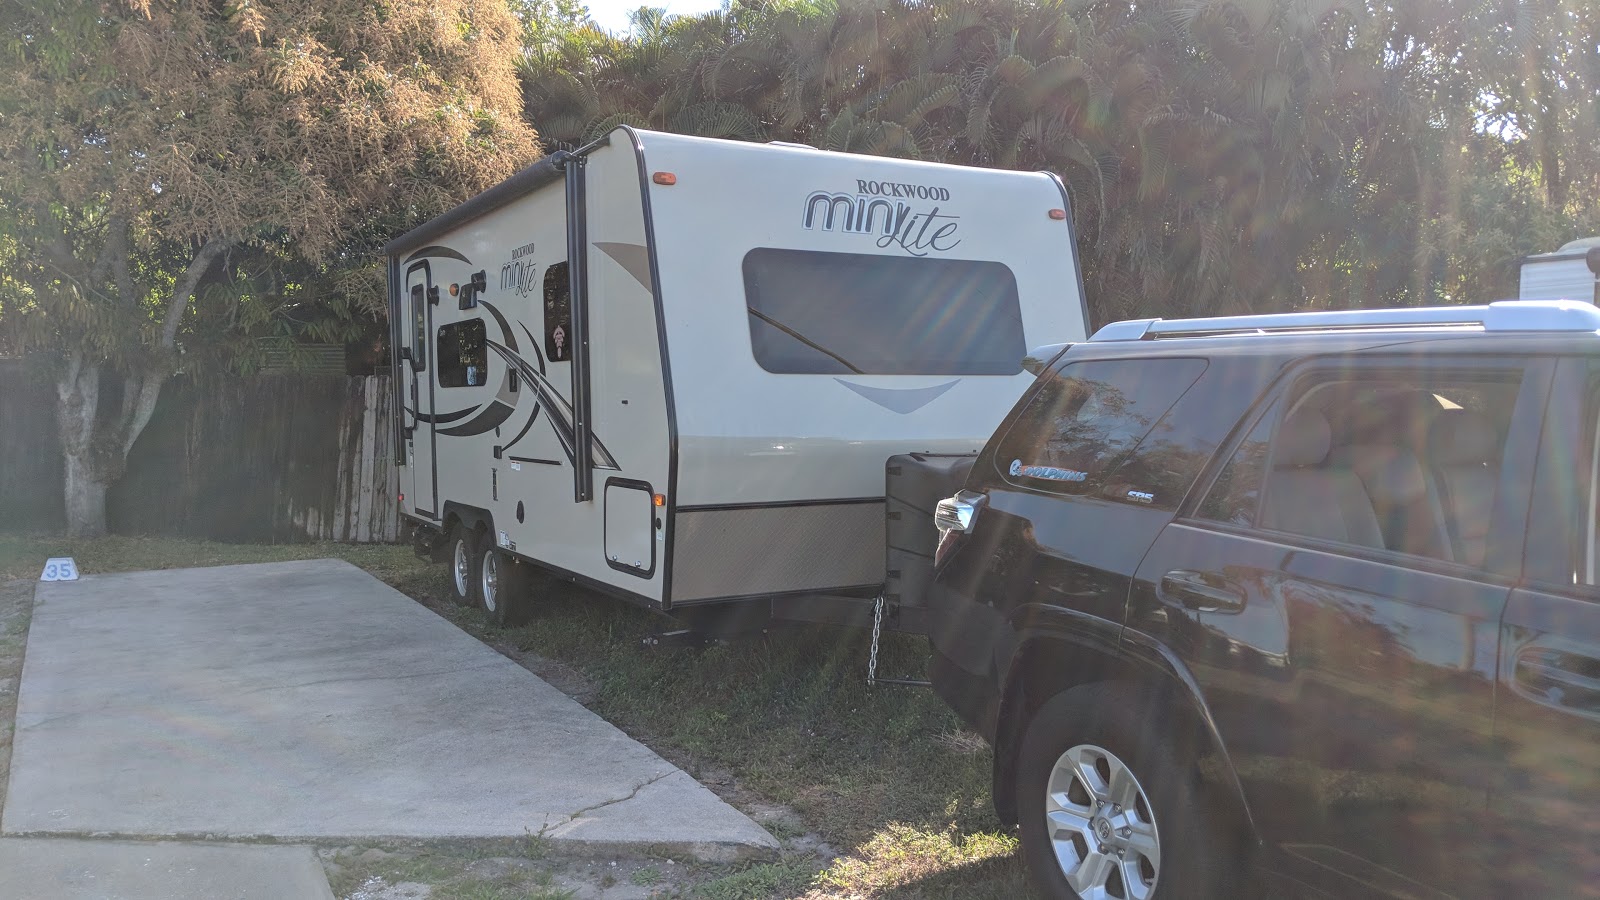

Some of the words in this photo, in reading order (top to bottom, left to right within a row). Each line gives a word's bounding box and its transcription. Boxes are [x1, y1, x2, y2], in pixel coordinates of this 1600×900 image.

[856, 179, 950, 202] ROCKWOOD
[1025, 466, 1088, 482] DOLPHINS
[46, 563, 71, 579] 35
